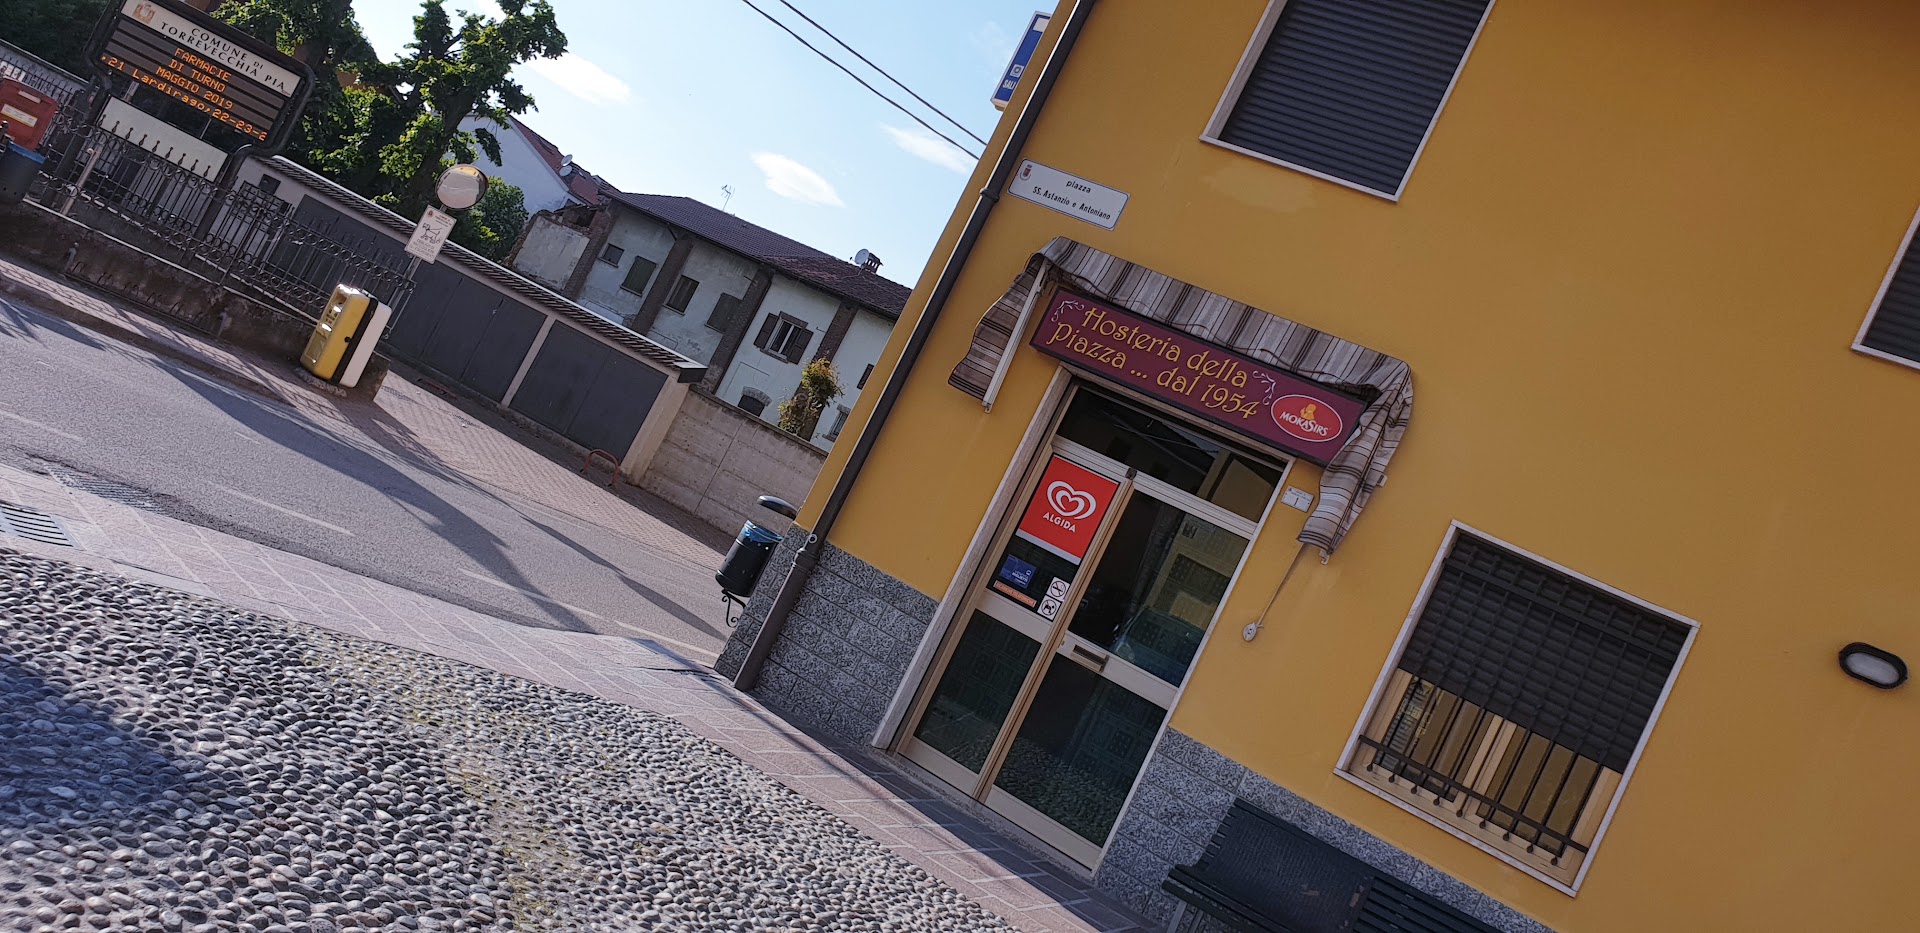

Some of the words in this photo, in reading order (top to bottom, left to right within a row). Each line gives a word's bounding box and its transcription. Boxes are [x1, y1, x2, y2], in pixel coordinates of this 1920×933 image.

[160, 21, 257, 77] TORREVECCHIA
[264, 74, 284, 91] PIA
[174, 47, 232, 82] FARMACIE
[191, 28, 248, 60] COMUNE
[253, 61, 264, 70] DI
[155, 66, 200, 93] MAGGIO
[203, 90, 233, 110] 2019
[168, 59, 185, 72] DI
[191, 69, 226, 93] TURNO
[1043, 190, 1070, 206] Astanzio
[1079, 203, 1111, 220] Antoniano
[1065, 180, 1092, 194] piazza
[1081, 307, 1181, 362] Hosteria
[1186, 350, 1248, 388] della
[1046, 322, 1127, 369] Piazza
[1156, 367, 1201, 396] dal
[1200, 384, 1260, 419] 1954
[1042, 511, 1076, 533] ALGIDA
